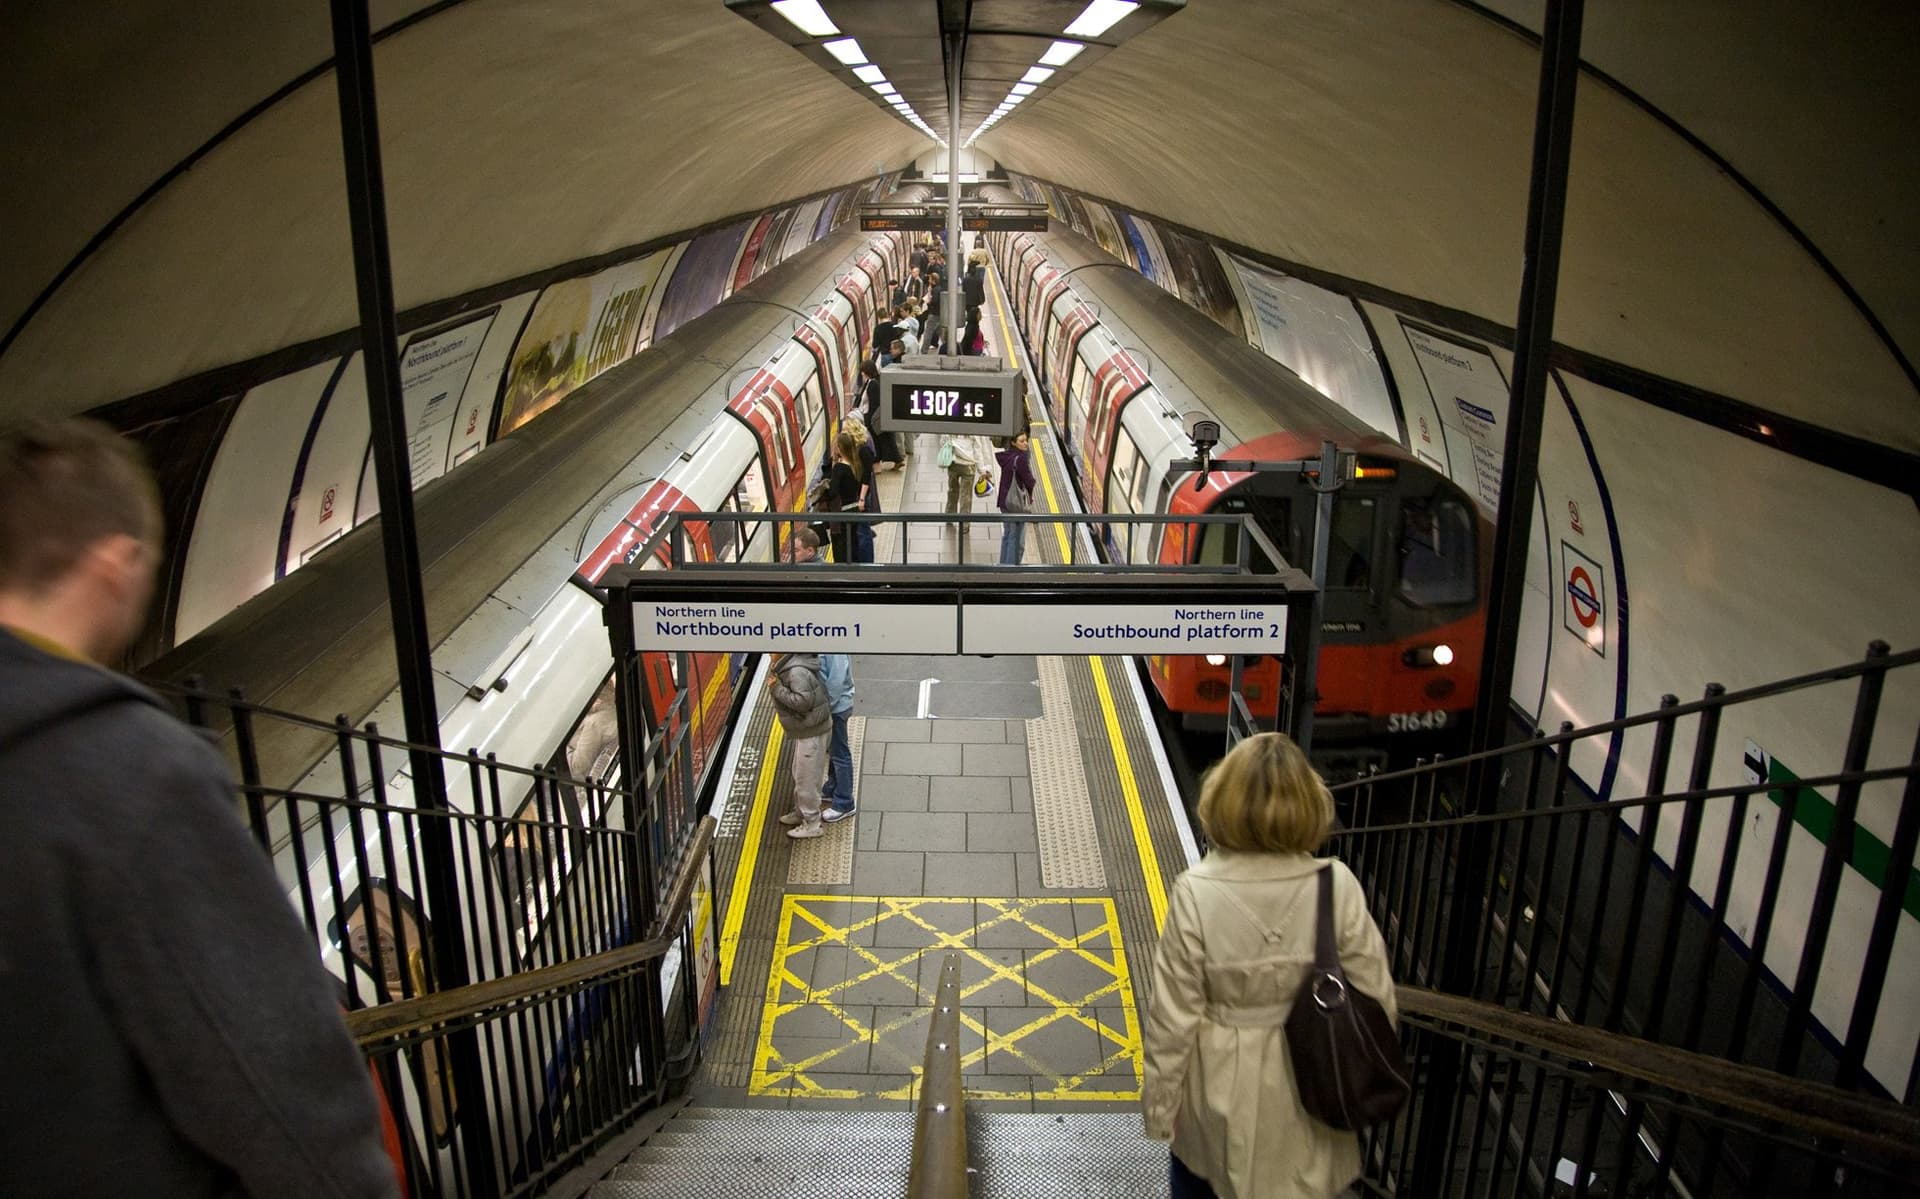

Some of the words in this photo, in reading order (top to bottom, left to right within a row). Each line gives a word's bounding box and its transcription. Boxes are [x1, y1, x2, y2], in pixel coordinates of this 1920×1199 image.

[910, 389, 960, 416] 1307
[963, 402, 984, 417] 16
[656, 606, 717, 618] Northern
[721, 606, 746, 618] line
[1174, 609, 1236, 620] Northern
[1240, 609, 1265, 620] line
[656, 621, 763, 637] Northbound
[770, 622, 848, 640] platform
[854, 623, 862, 637] 1
[1073, 623, 1181, 639] Southbound
[1186, 624, 1264, 642] platform
[1269, 623, 1279, 638] 2
[1387, 709, 1448, 733] 51649
[730, 773, 755, 798] THE
[718, 801, 747, 837] MIND
